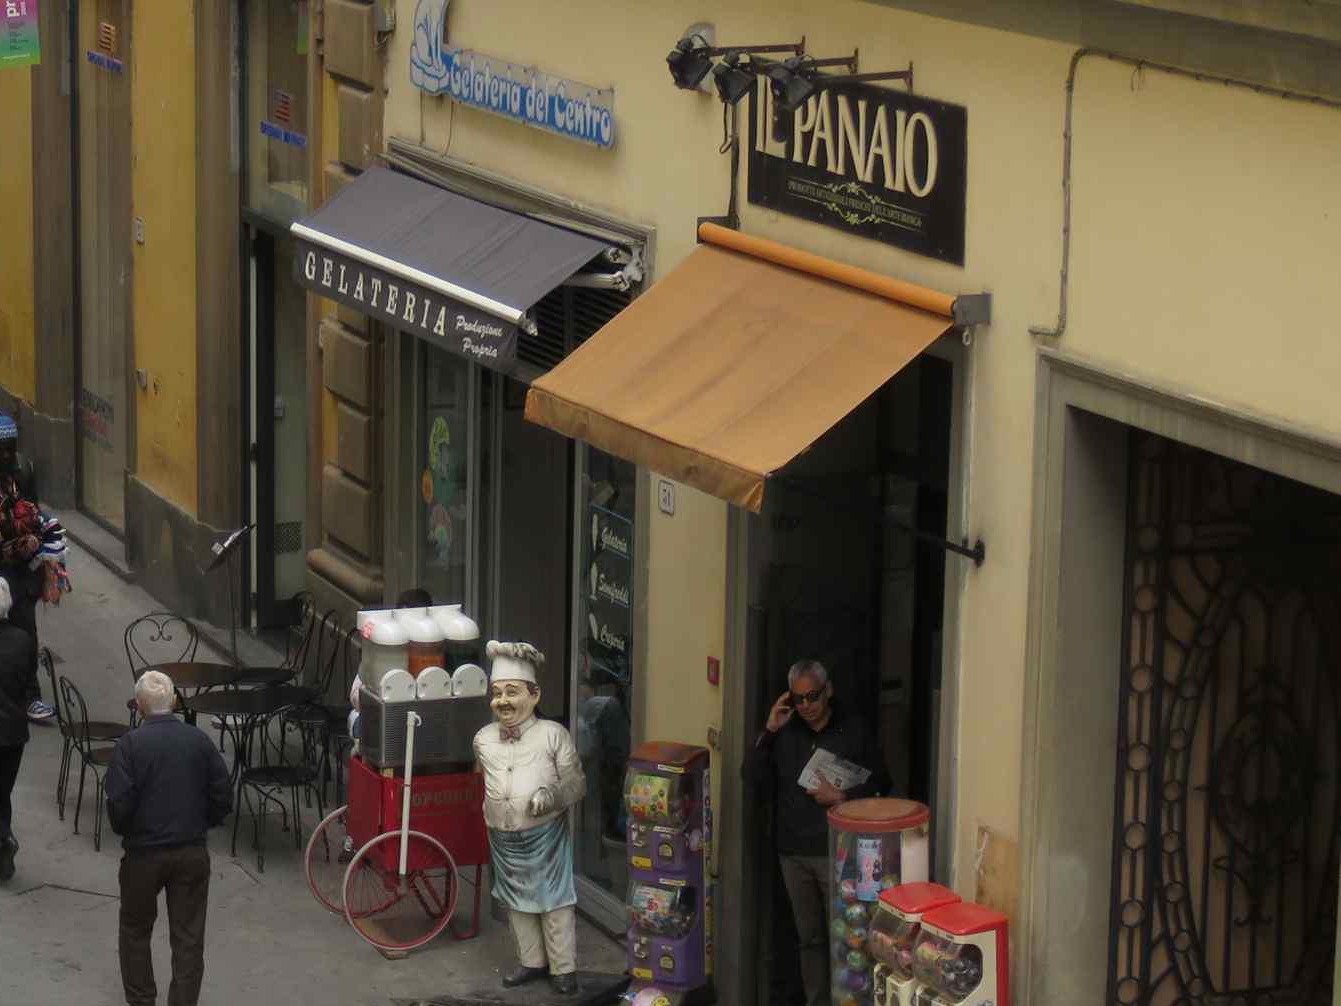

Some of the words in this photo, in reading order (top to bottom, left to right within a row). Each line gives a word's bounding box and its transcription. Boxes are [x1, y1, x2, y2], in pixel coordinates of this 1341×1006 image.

[450, 51, 521, 114] Gelateria
[526, 71, 550, 123] del
[554, 80, 612, 143] Centro
[792, 89, 938, 198] PANAIO
[304, 251, 448, 337] GELATERIA
[455, 314, 504, 339] Produzione
[461, 337, 499, 358] Propria
